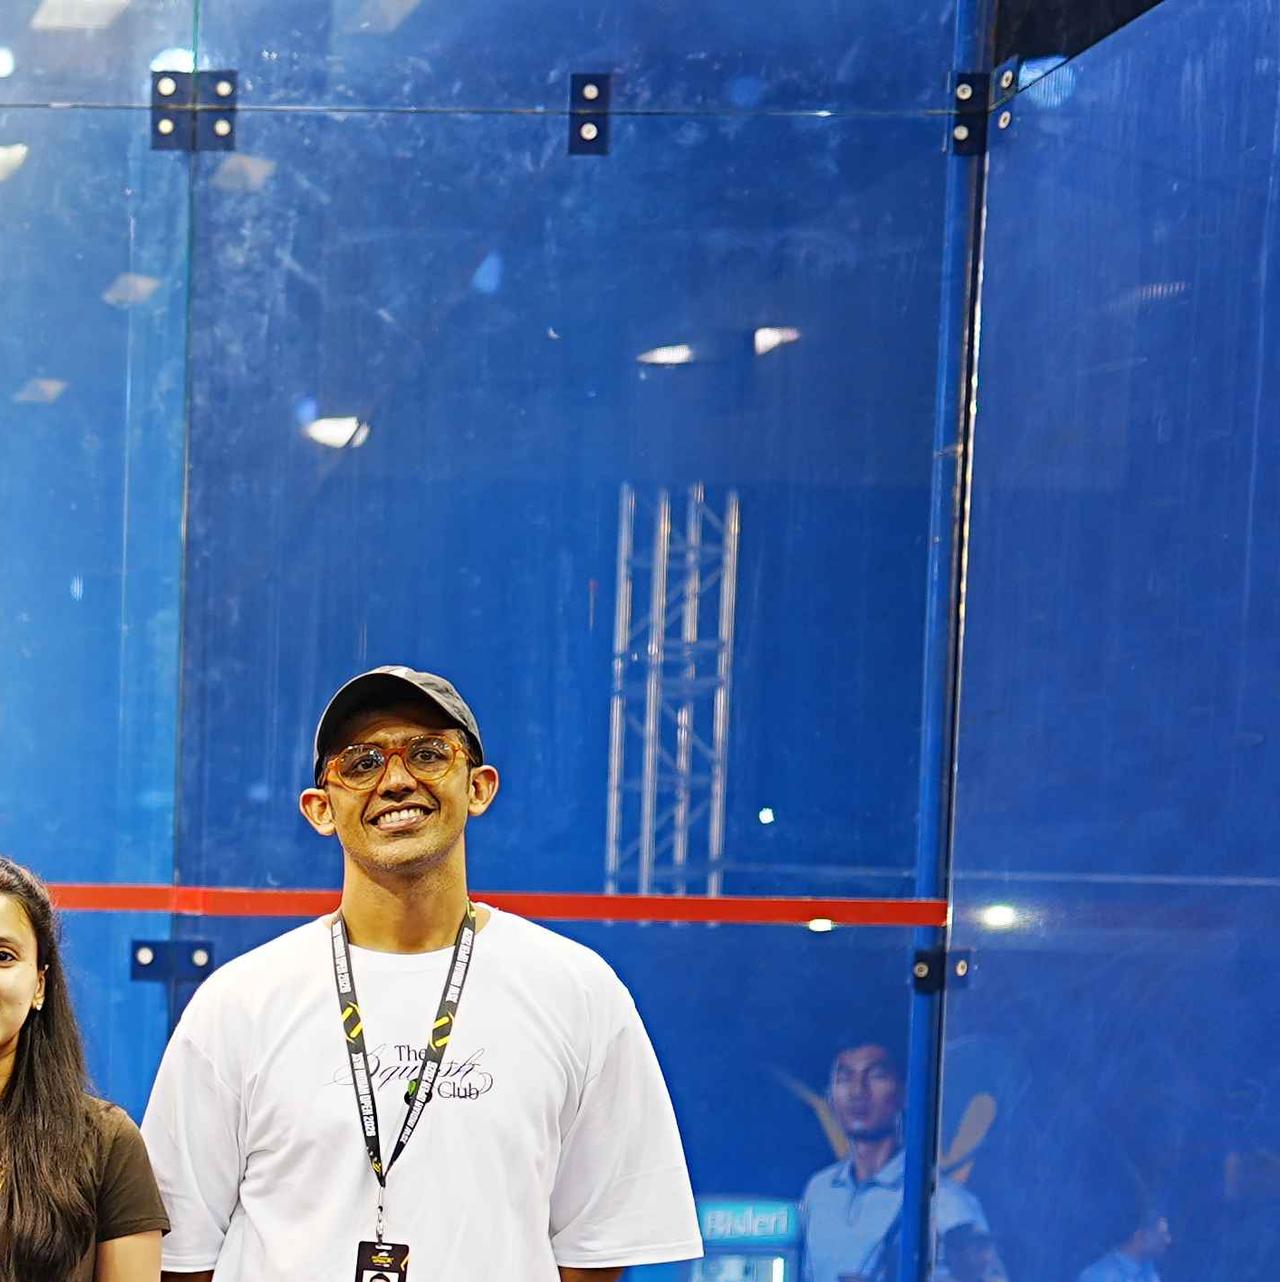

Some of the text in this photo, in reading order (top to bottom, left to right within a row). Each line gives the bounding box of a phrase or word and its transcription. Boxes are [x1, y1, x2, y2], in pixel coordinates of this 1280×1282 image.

[395, 1045, 427, 1061] The
[324, 1043, 493, 1094] Sqush
[438, 1081, 479, 1100] Club
